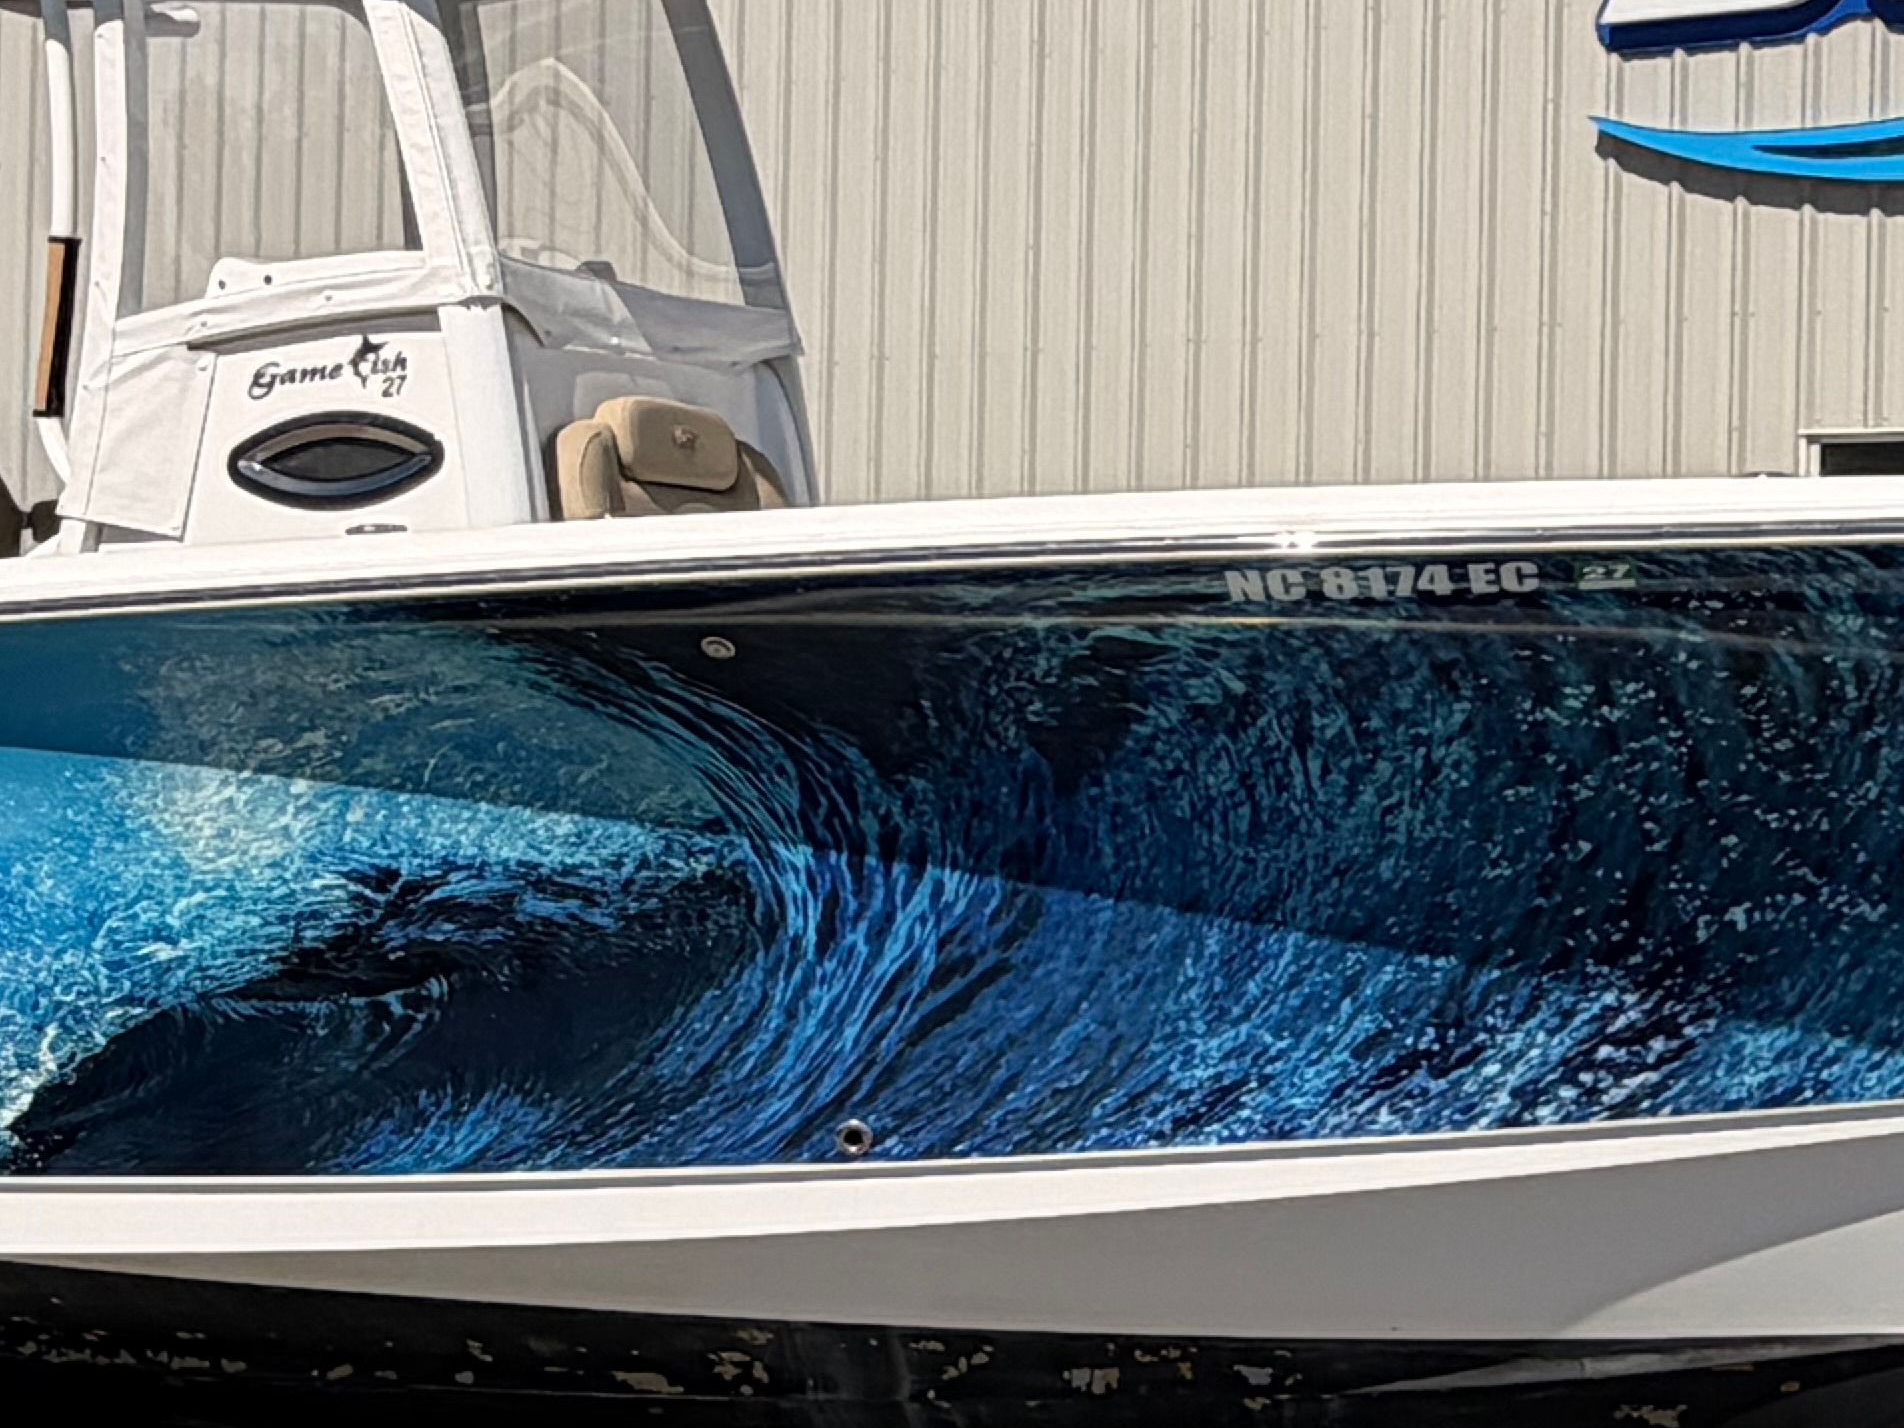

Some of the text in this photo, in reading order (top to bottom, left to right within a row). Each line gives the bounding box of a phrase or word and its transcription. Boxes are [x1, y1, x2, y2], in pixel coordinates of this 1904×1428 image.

[381, 374, 408, 398] 27
[1224, 561, 1540, 601] NC 8174 EC
